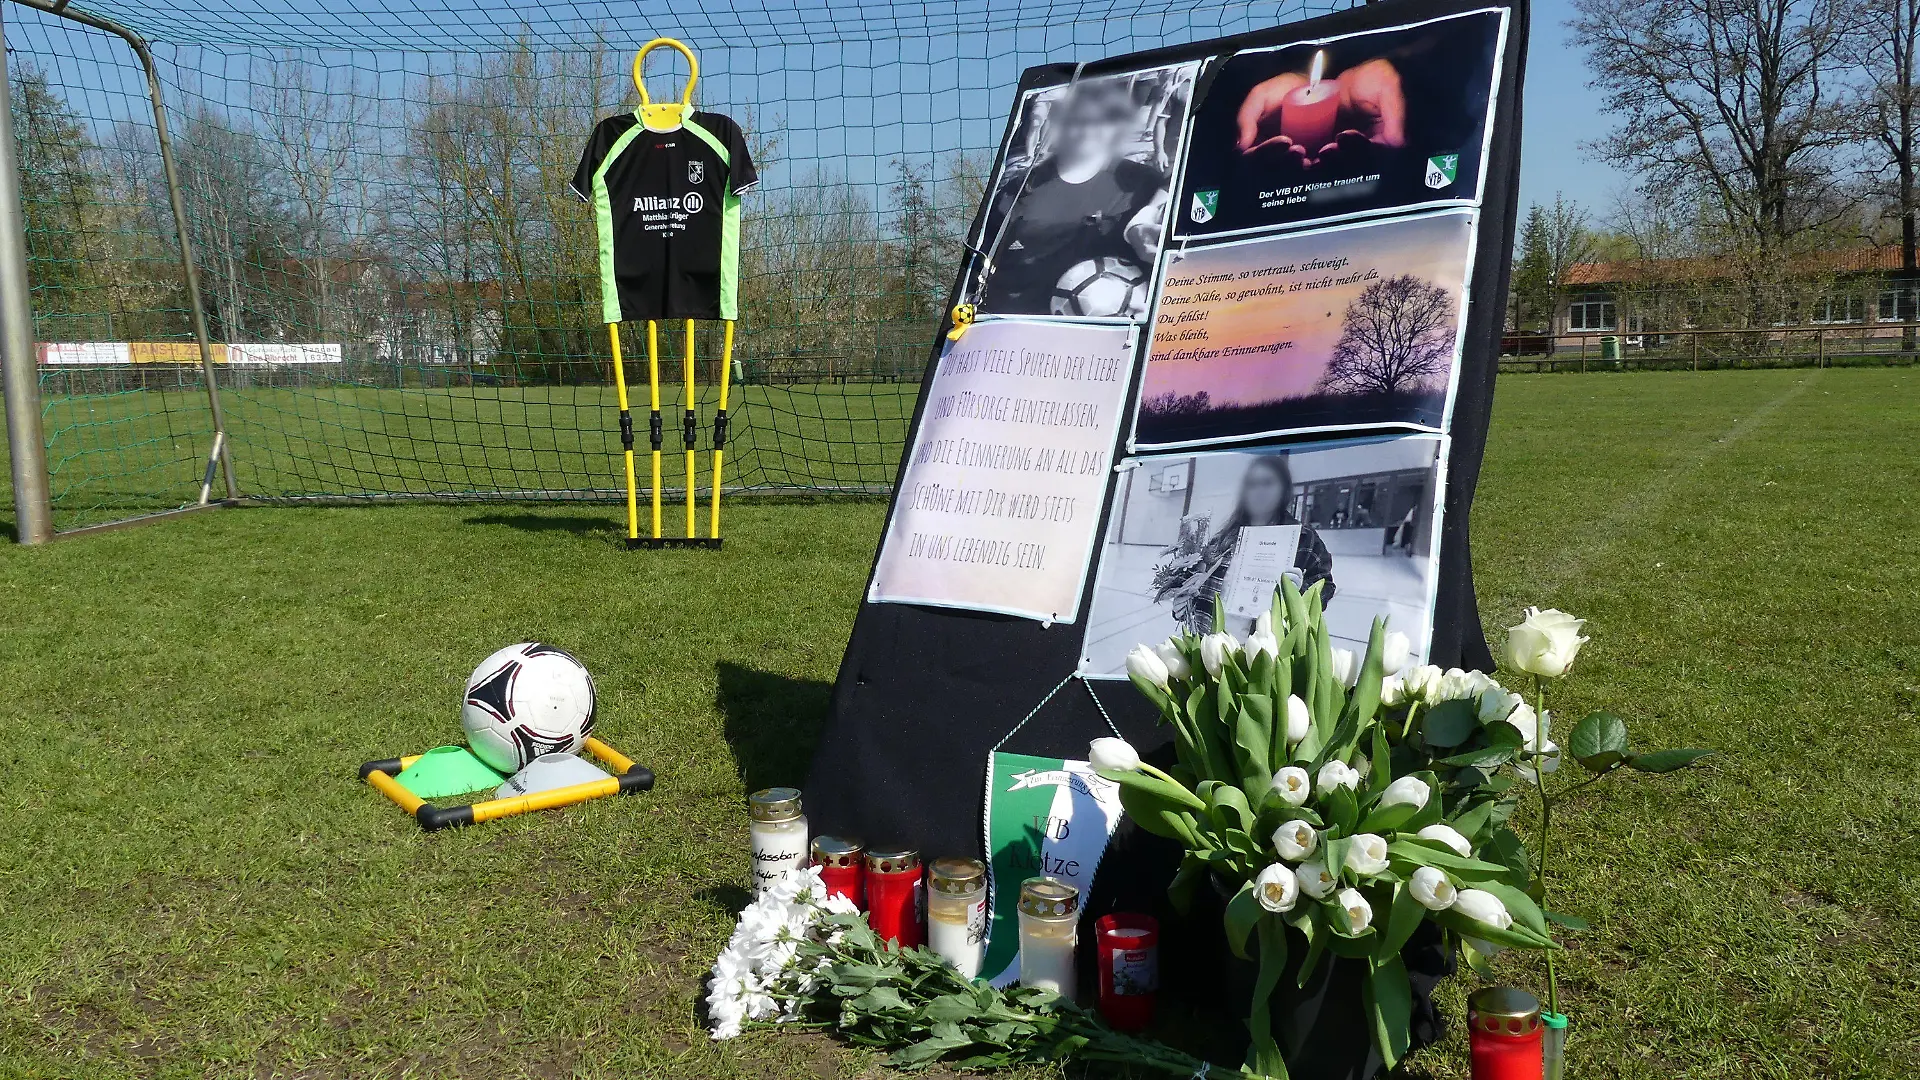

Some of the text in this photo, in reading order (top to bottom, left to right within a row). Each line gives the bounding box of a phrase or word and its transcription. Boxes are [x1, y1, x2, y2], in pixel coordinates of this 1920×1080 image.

[1258, 191, 1274, 199] Der
[1292, 185, 1304, 194] 07
[1304, 181, 1332, 192] Klötze
[1334, 175, 1364, 187] trauert
[1365, 174, 1380, 182] um
[633, 196, 681, 212] Allianz
[1261, 195, 1308, 208] seine liebe
[1165, 256, 1350, 288] Deine Stimme, so vertraut, schweigt.
[1162, 268, 1380, 306] Deine Nähe, so gewohnt, ist nicht mehr da.
[1158, 310, 1209, 328] Du fehlst!
[1154, 330, 1210, 342] Was bleibt,
[1150, 340, 1294, 362] sind dankbare Erinnerungen.
[956, 350, 982, 374] HAST
[983, 349, 1016, 375] VIELE
[1016, 348, 1061, 378] SPUREN
[1064, 355, 1084, 380] DER
[1088, 354, 1121, 382] LIEBE
[934, 391, 1099, 430] UND FÜRSORGE HINTERLASSEN,
[933, 440, 954, 464] DIE
[956, 438, 1032, 472] ERINNERUNG
[1034, 447, 1056, 472] AN
[1056, 450, 1077, 474] ALL
[1080, 451, 1104, 476] DAS
[910, 482, 1076, 523] SCHÖNE MIT DIR WIRD STETS
[908, 532, 1046, 570] IN UNS LEBENDIG SEIN.
[1033, 816, 1070, 840] VfB
[751, 848, 799, 865] nfassbar
